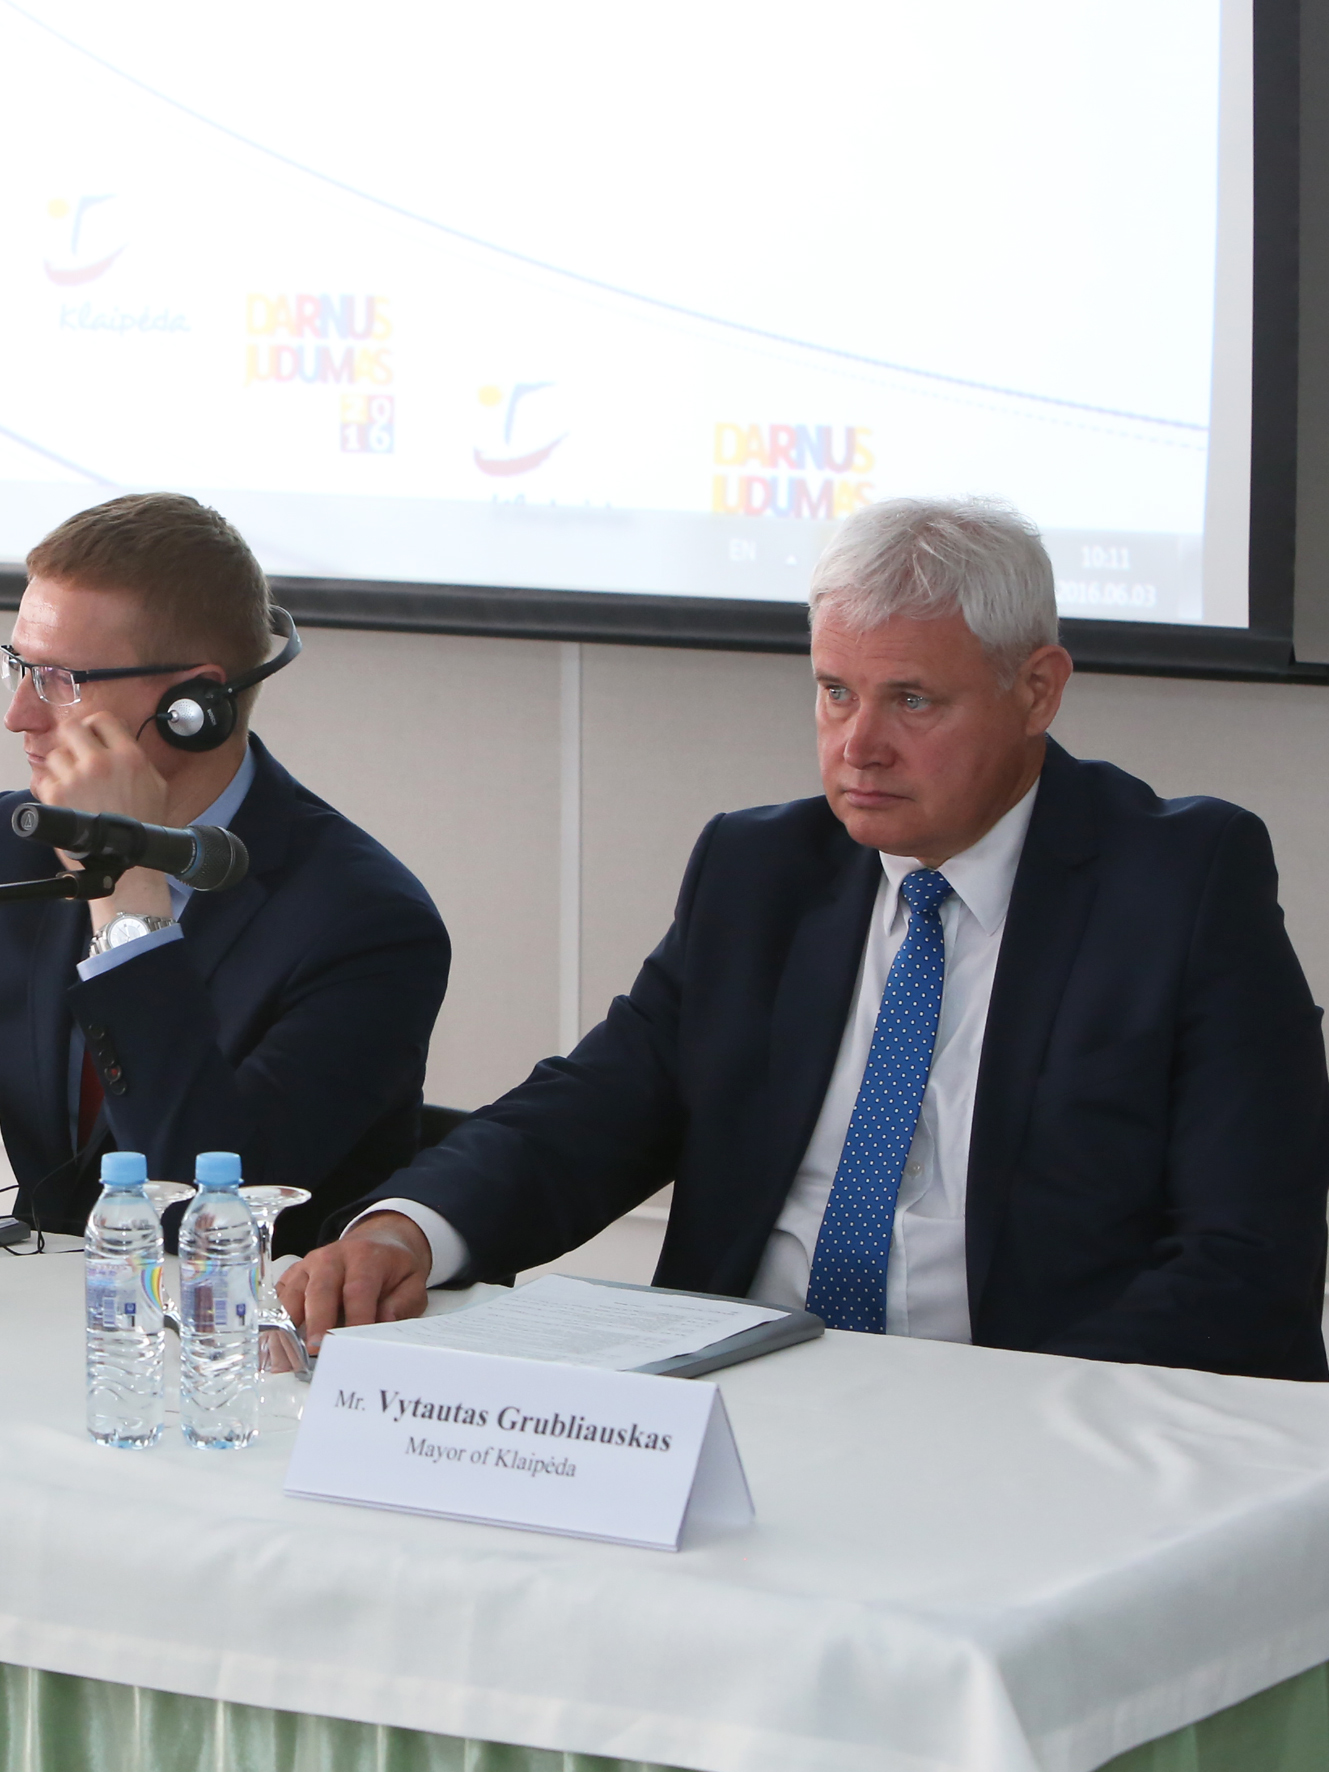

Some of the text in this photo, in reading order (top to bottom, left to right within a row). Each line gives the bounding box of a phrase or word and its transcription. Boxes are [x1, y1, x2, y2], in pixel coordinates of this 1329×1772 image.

[244, 292, 393, 341] DARNUS
[242, 344, 394, 387] JUDUMAS
[713, 421, 877, 476] DARNUS
[730, 540, 757, 562] EN
[1081, 544, 1131, 570] 10:11
[335, 1389, 673, 1453] Mr. Vytautas Grubliauskas
[405, 1436, 577, 1479] Mayor of Klaipėda
